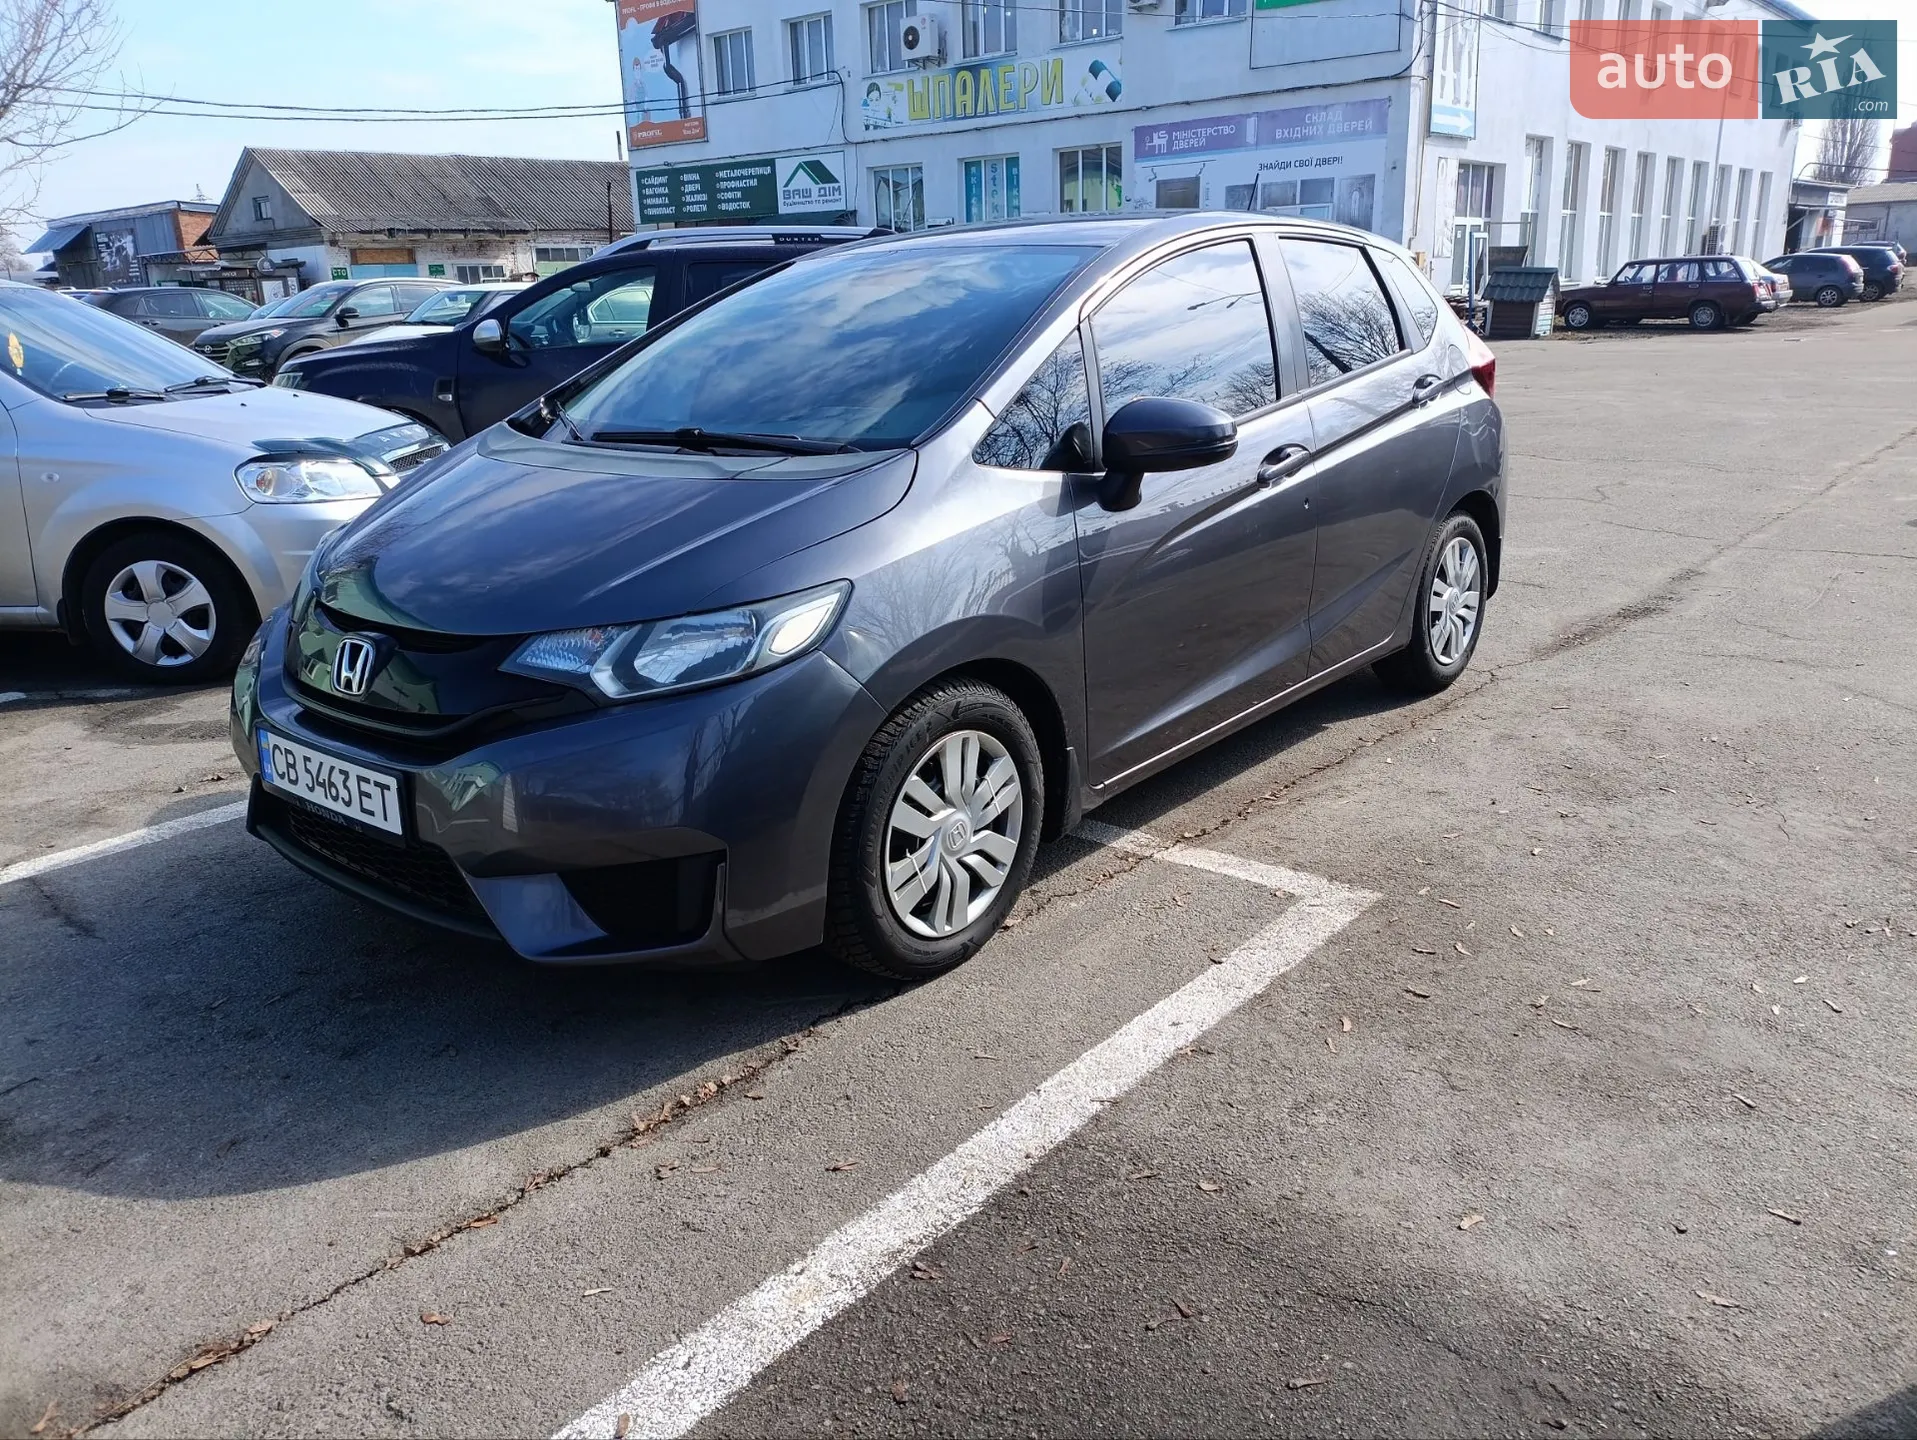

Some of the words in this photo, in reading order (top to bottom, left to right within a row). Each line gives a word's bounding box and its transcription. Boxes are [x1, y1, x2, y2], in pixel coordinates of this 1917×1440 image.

[907, 58, 1064, 121] ШПАЛЕРИ
[1305, 110, 1343, 124] СКЛАД
[1172, 125, 1236, 141] МІНІСТЕРСТВО
[1275, 126, 1323, 139] ВХІДНИХ
[1327, 120, 1373, 134] ДВЕРЕЙ
[1172, 138, 1206, 151] ДВЕРЕЙ
[1258, 160, 1292, 171] ЗНАЙДИ
[1294, 156, 1313, 168] СВОЇ
[1315, 156, 1343, 168] ДВЕРІ!
[719, 166, 771, 178] МЕТАЛОЧЕРЕПИЦЯ
[782, 187, 812, 200] ВАШ
[817, 185, 842, 198] ДІМ
[332, 268, 347, 276] СТО
[271, 743, 299, 786] CB
[303, 756, 352, 808] 5463
[356, 775, 391, 822] ET
[305, 801, 348, 826] HONDA
